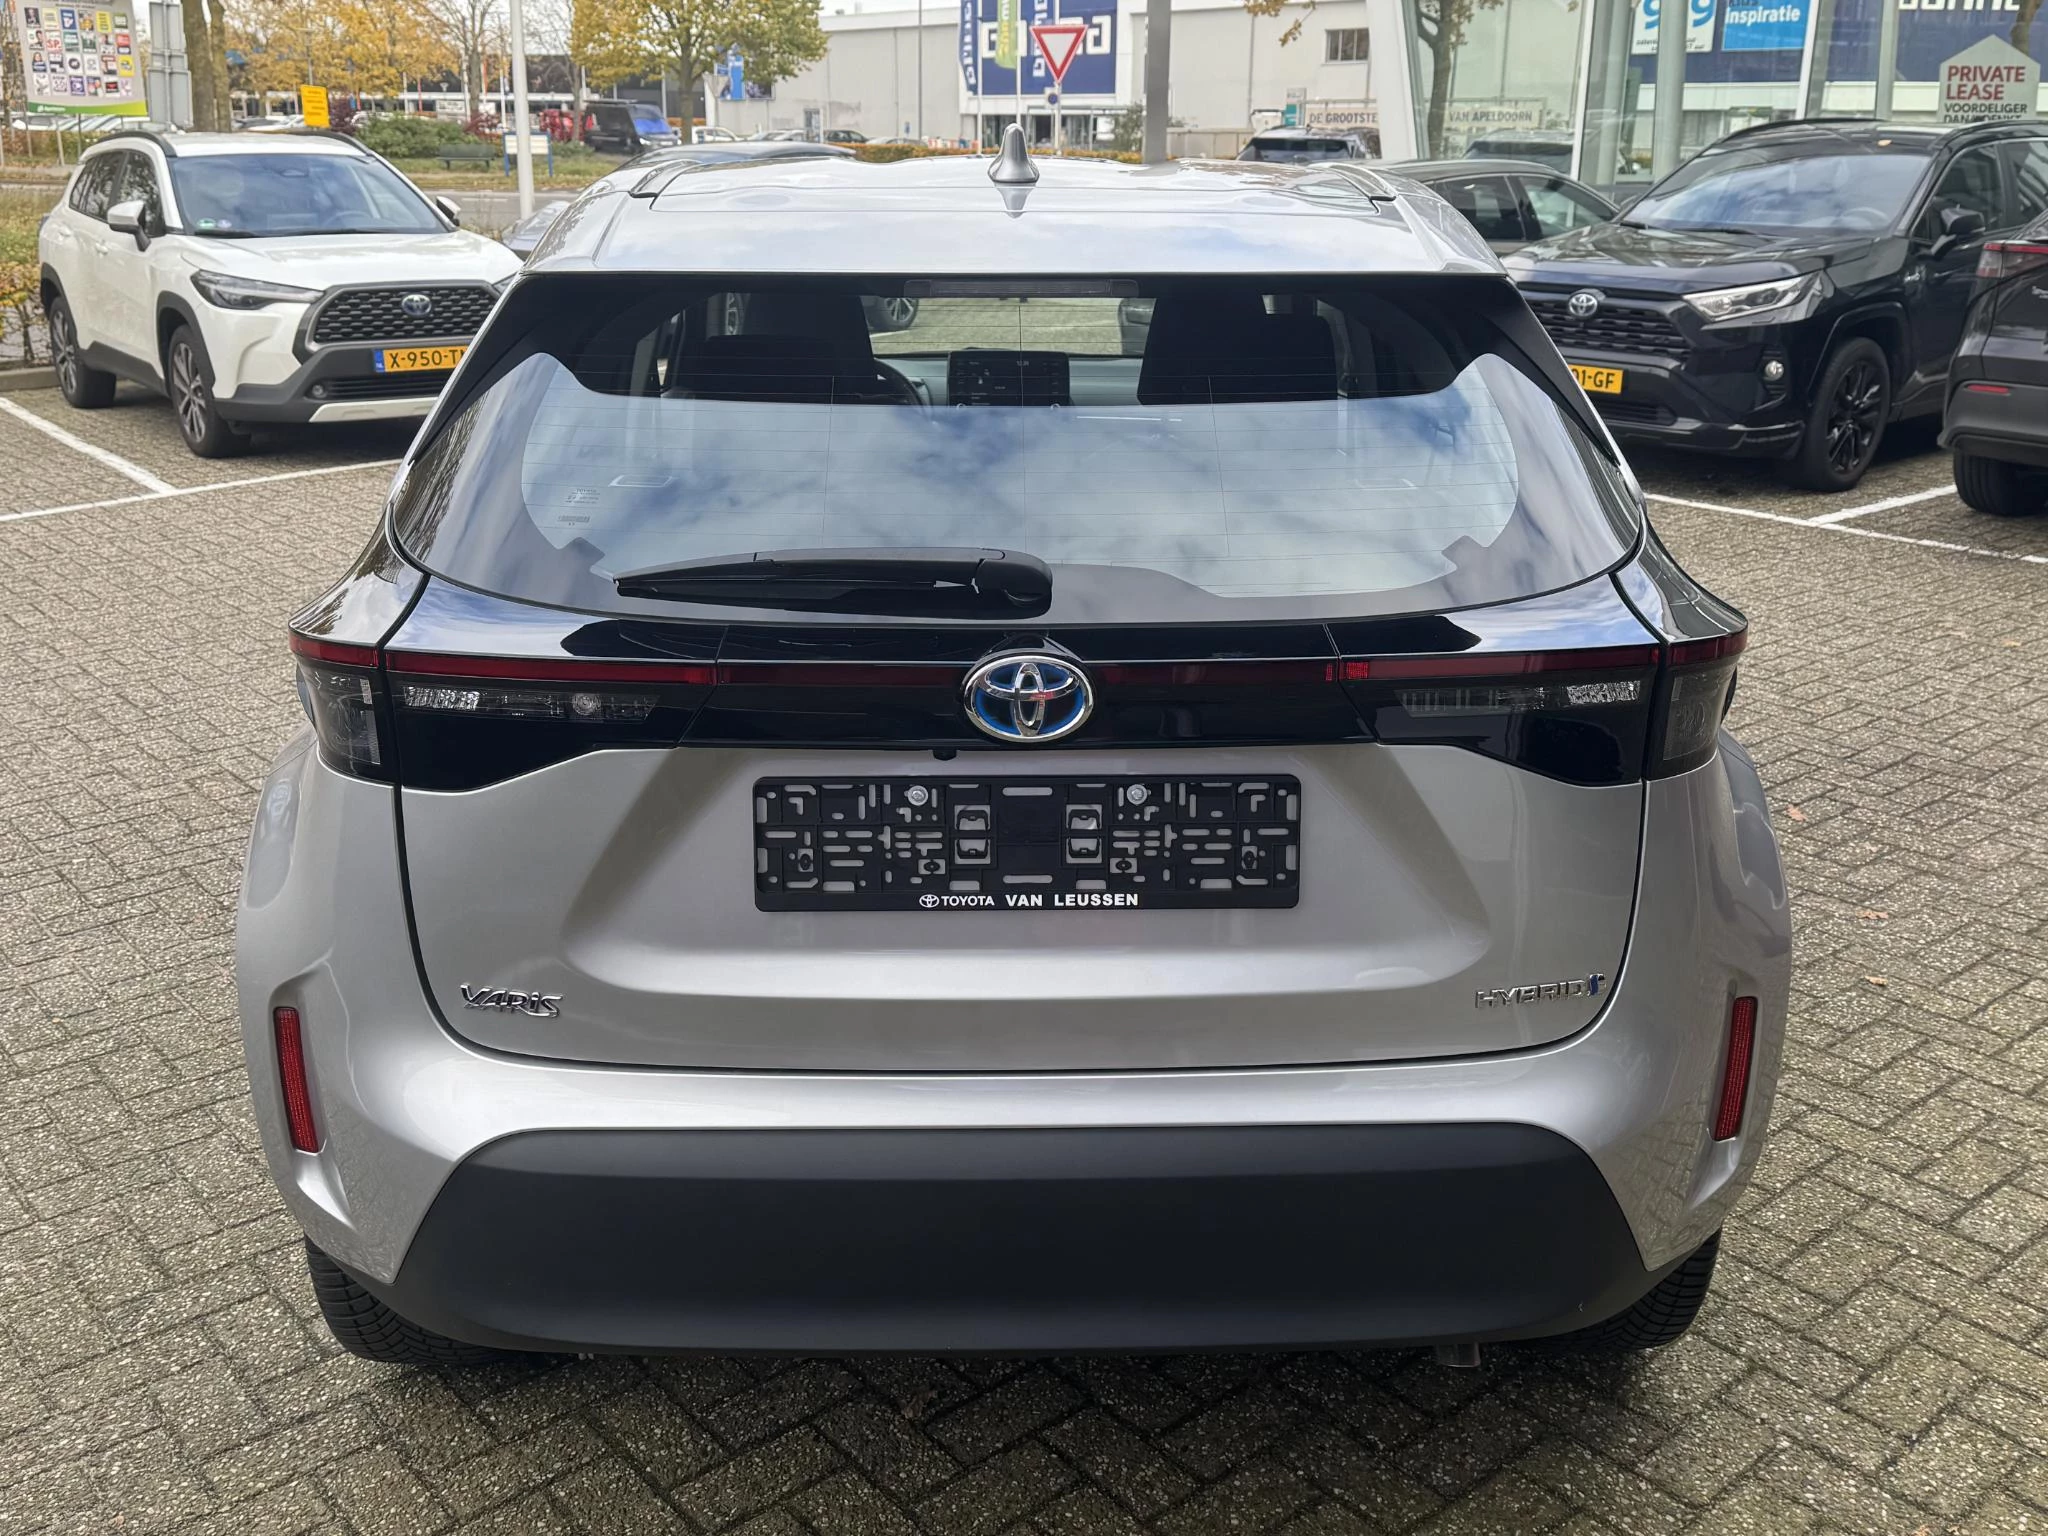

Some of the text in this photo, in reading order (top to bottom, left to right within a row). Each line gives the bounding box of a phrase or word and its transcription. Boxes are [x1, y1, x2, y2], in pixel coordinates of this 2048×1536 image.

[1725, 4, 1801, 27] inspiratie
[1947, 65, 2026, 82] PRIVATE
[1946, 83, 2005, 100] LEASE
[1471, 110, 1533, 122] APELDOORN
[1944, 102, 2028, 114] VOORDELIGER
[941, 893, 1139, 907] TOYOTA VAN LEUSSEN
[1474, 979, 1586, 1008] HYBRID
